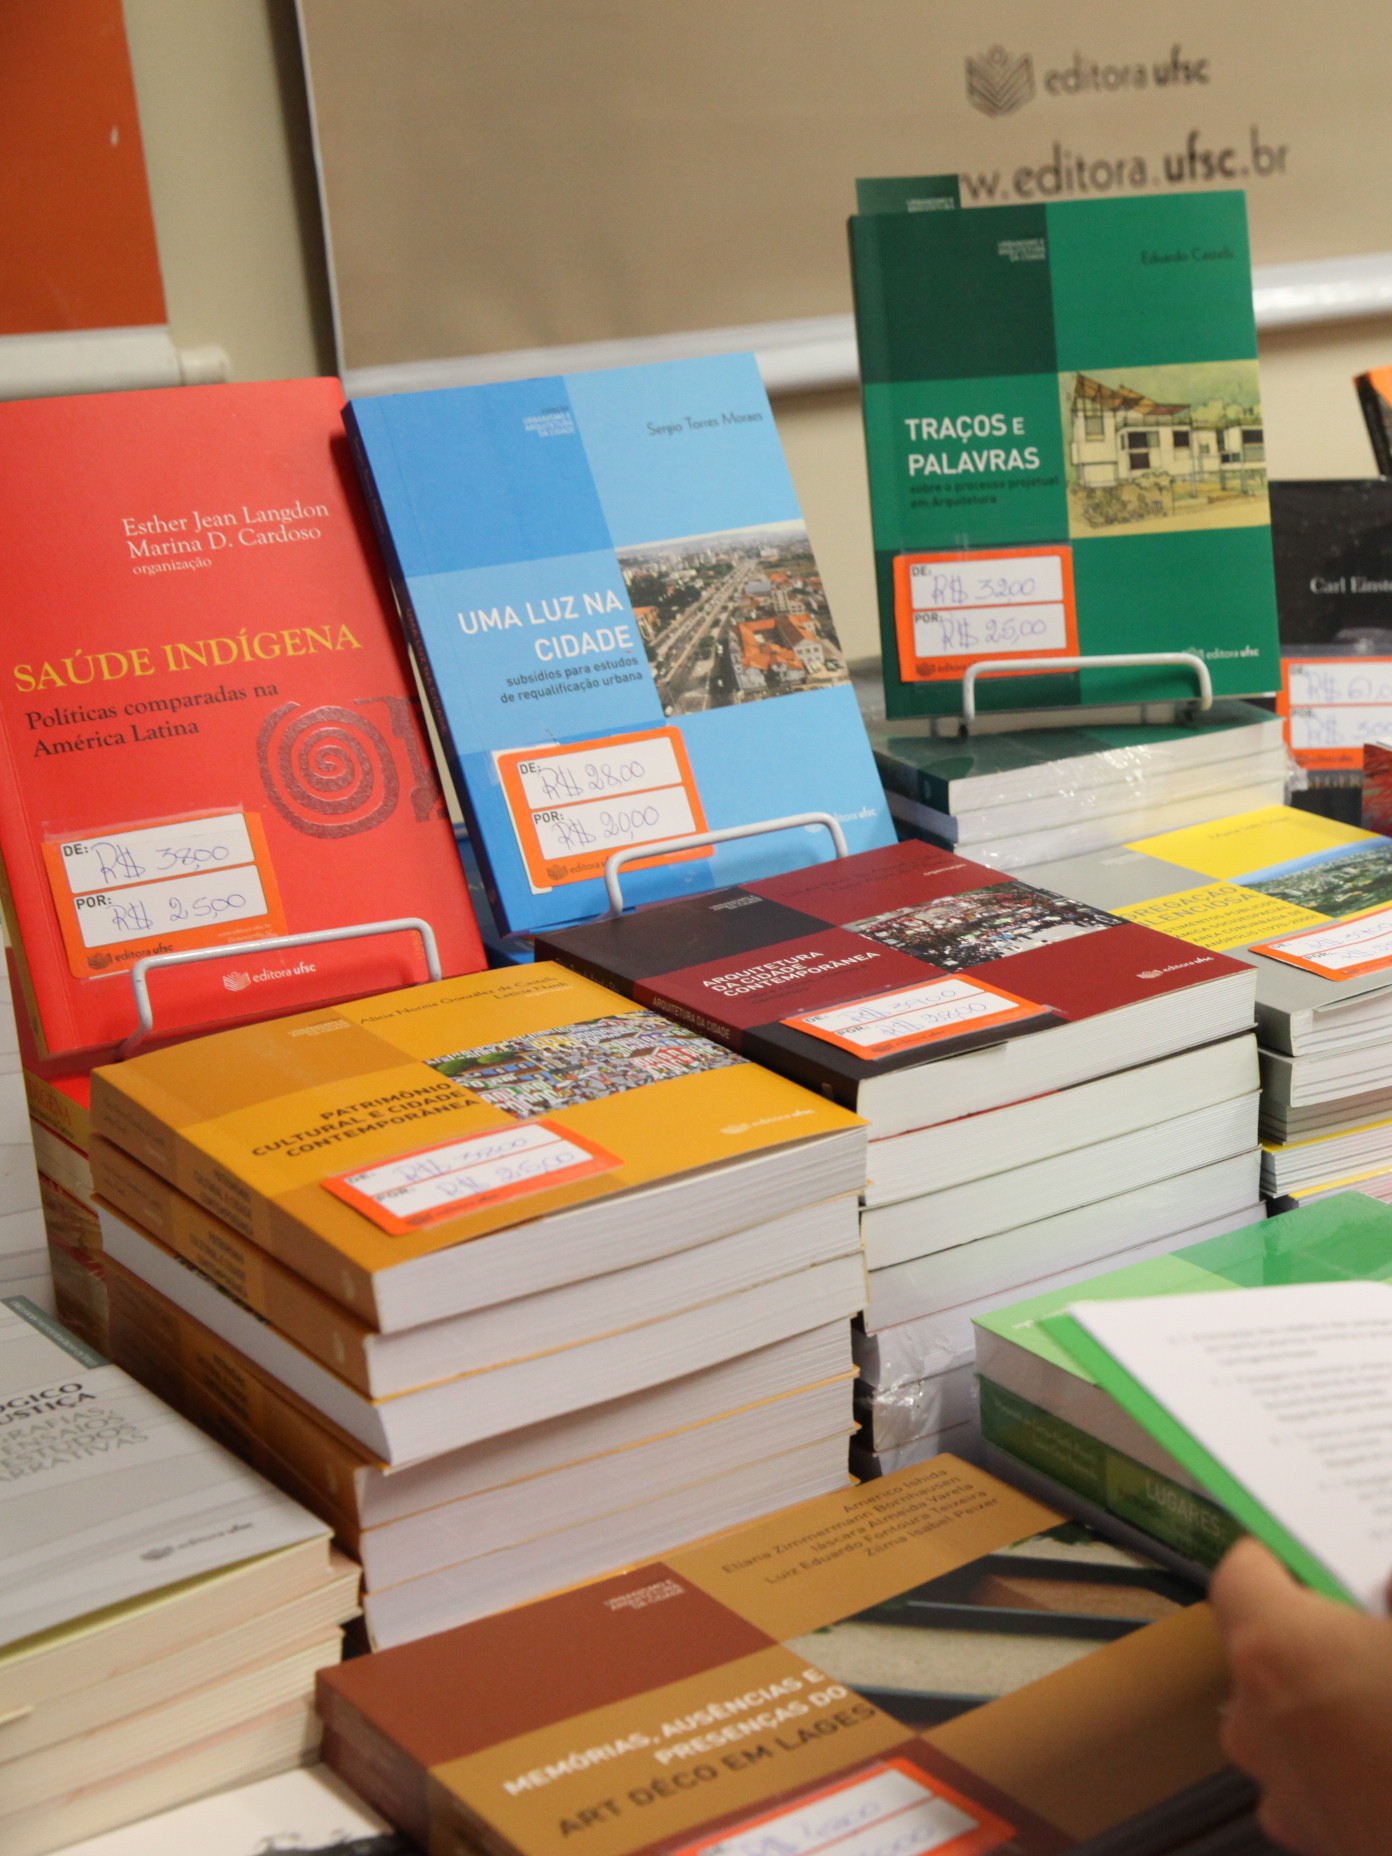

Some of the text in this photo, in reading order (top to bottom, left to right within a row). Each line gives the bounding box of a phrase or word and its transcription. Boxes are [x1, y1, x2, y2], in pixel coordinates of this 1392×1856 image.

[1044, 43, 1209, 95] editora ufsc
[646, 421, 683, 438] Sergio
[685, 415, 720, 431] Torres
[905, 414, 1026, 443] TRAÇOS E
[908, 447, 1041, 477] PALAVRAS
[122, 501, 330, 536] Esther Jean Langdon
[129, 524, 322, 559] Marina D. Cardoso
[132, 556, 213, 576] organização
[1309, 576, 1346, 594] Carl
[457, 589, 624, 635] UMA LUZ NA
[13, 622, 364, 693] SAÚDE INDÍGENA
[534, 625, 634, 662] CIDADE
[500, 671, 644, 704] de requalificação urbana
[506, 656, 640, 687] subsídios para estudos
[25, 681, 279, 733] Políticas comparadas na
[33, 718, 201, 759] América Latina
[519, 761, 543, 775] DE:
[533, 811, 565, 825] POR:
[63, 843, 89, 858] DE:
[76, 894, 113, 911] POR:
[1287, 910, 1302, 918] DE
[115, 943, 174, 963] editora ufsc
[702, 951, 825, 988] ARQUITETURA
[1162, 955, 1214, 974] editora ufsc
[252, 962, 317, 984] editora ufsc
[711, 963, 807, 993] DA CIDADE
[723, 951, 881, 997] CONTEMPORÂNEA
[360, 1012, 395, 1024] Alicia
[396, 1001, 439, 1016] Norma
[652, 996, 731, 1040] ARQUITETURA DA CIDADE
[803, 1013, 829, 1024] DE:
[835, 1025, 871, 1037] POR:
[320, 1081, 452, 1121] PATRIMÔNIO
[251, 1090, 468, 1157] CULTURAL E CIDADE
[286, 1098, 481, 1158] CONTEMPORÂNEA
[1145, 1480, 1221, 1538] LUGARES
[502, 1667, 827, 1798] MEMÓRIAS, AUSÊNCIAS E
[654, 1683, 850, 1766] PRESENÇAS DO
[557, 1702, 879, 1839] ART DÉCO EM LAGES
